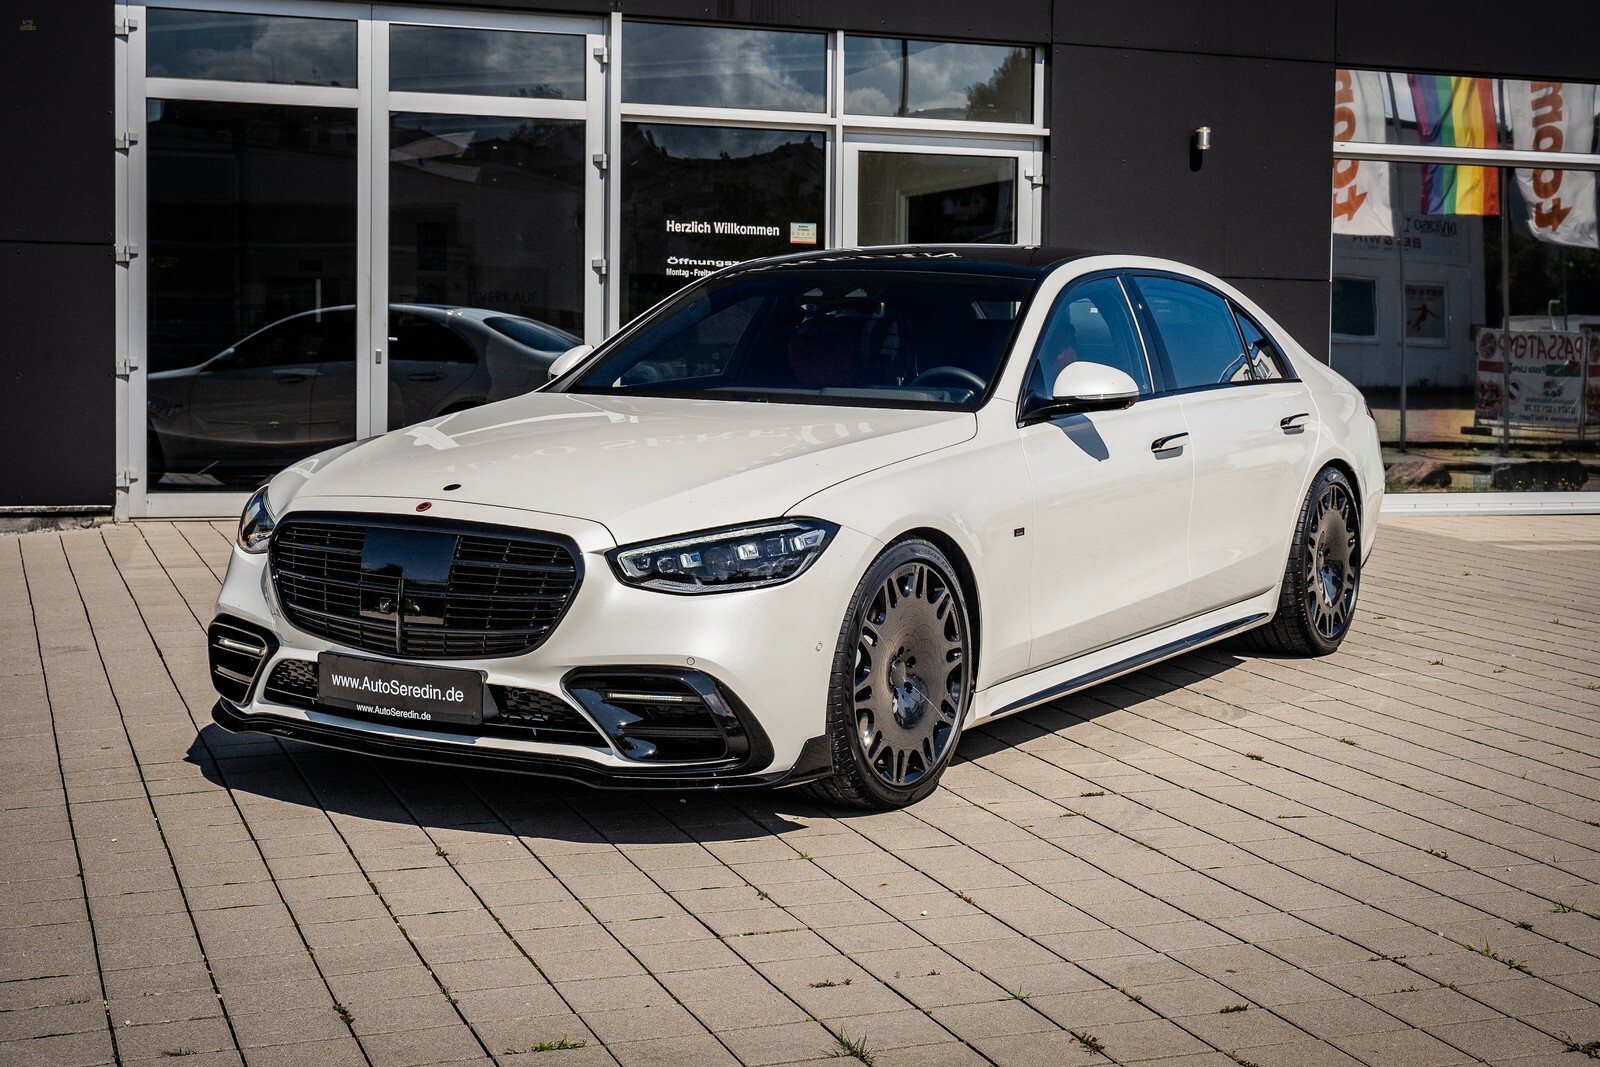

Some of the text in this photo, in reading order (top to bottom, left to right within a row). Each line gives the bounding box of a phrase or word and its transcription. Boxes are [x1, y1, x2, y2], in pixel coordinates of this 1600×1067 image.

[666, 219, 711, 234] Herzlich
[713, 221, 780, 236] Willkommen
[666, 267, 690, 278] Montag
[331, 673, 464, 703] www.AutoSeredin.de
[356, 703, 432, 721] www.AutoSeredin.de
